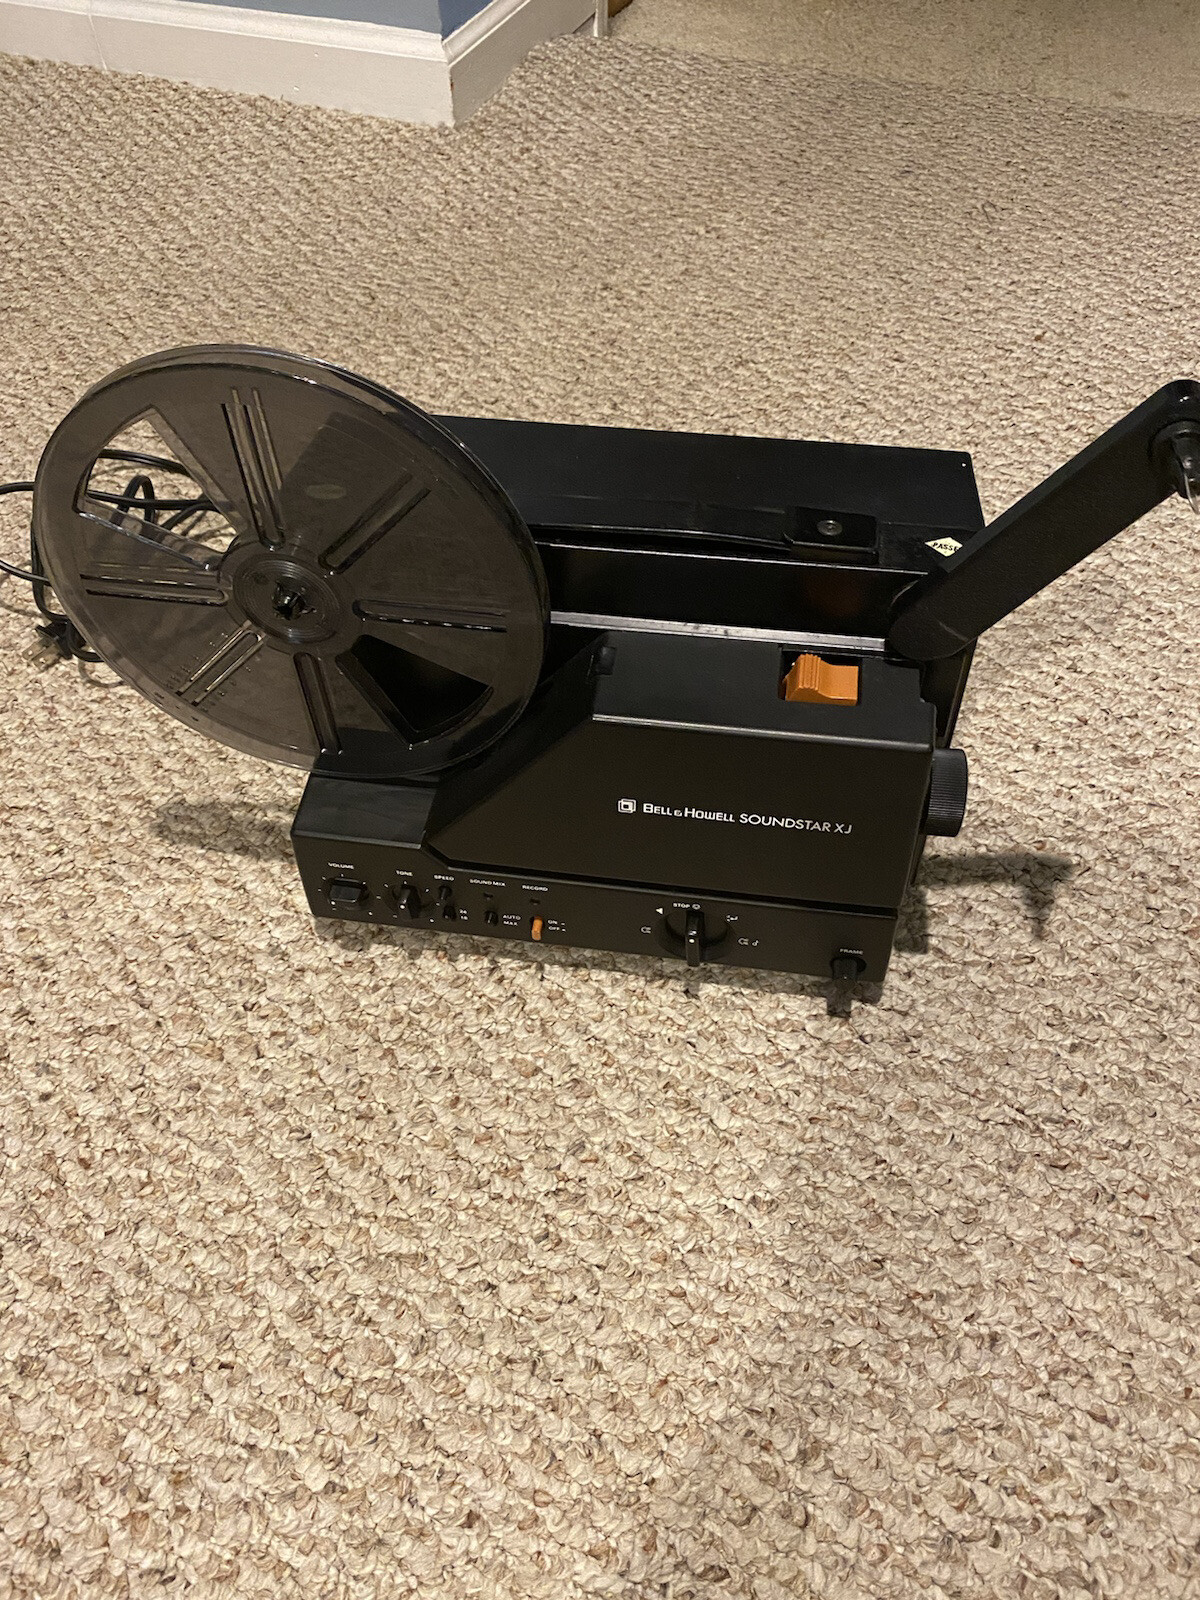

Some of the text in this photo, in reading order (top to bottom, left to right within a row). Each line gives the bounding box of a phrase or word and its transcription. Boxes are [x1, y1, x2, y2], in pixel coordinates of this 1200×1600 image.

[932, 542, 959, 552] PASSE
[642, 803, 673, 816] BELL
[684, 807, 736, 823] HOWELL
[739, 813, 832, 832] SOUNDSTAR
[833, 823, 853, 834] XJ
